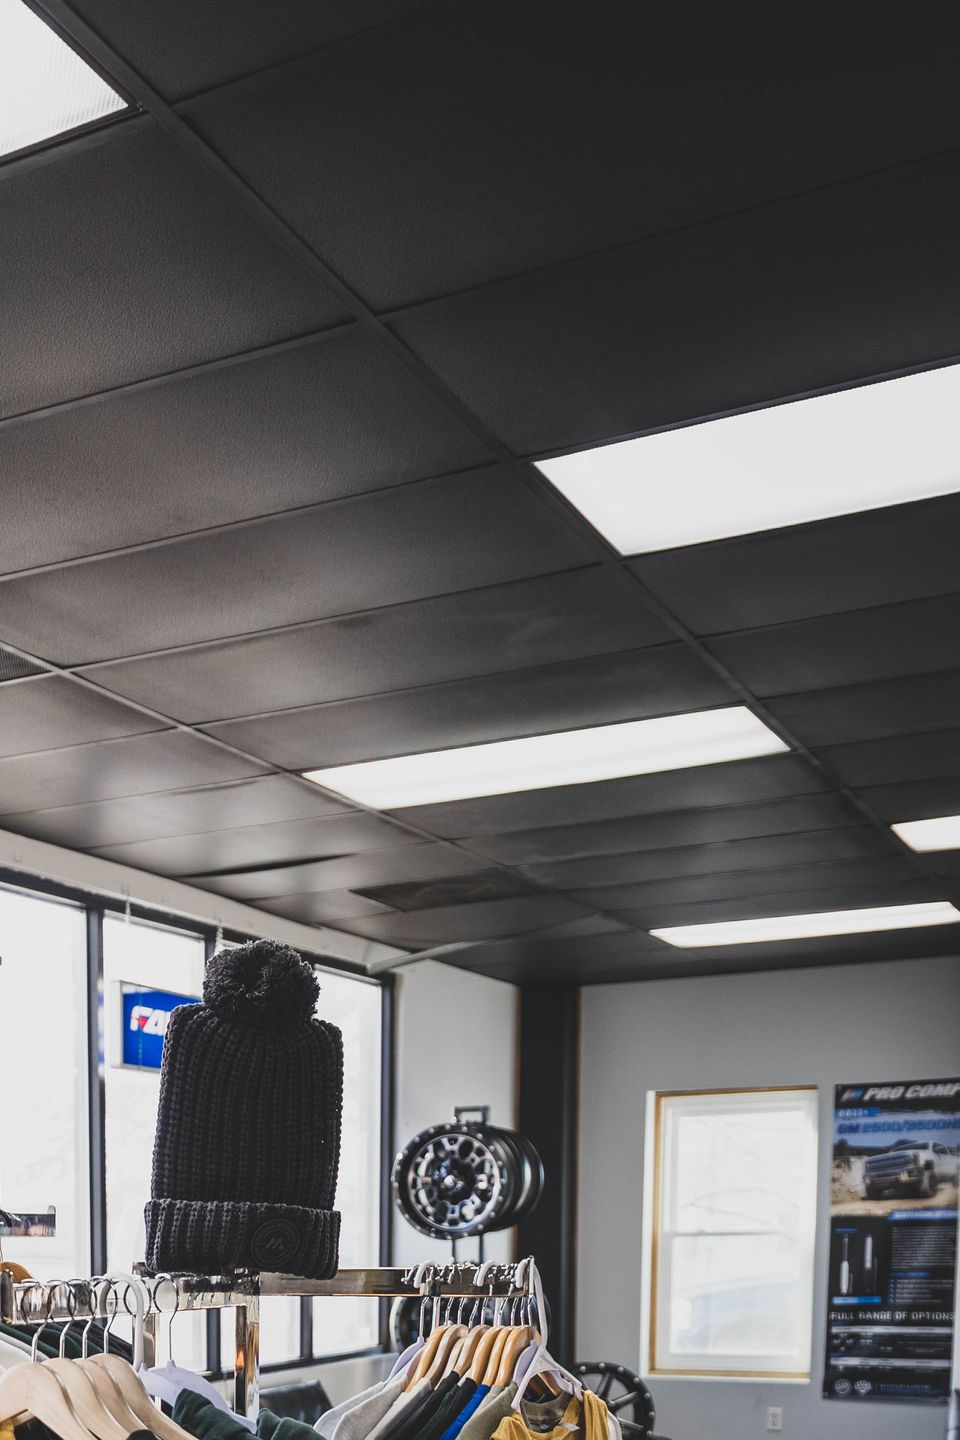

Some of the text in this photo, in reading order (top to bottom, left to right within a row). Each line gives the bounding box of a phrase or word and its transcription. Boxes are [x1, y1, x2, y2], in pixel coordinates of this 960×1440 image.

[862, 1086, 905, 1100] PRO
[831, 1310, 956, 1320] FULL RANGE OF OPTIONS
